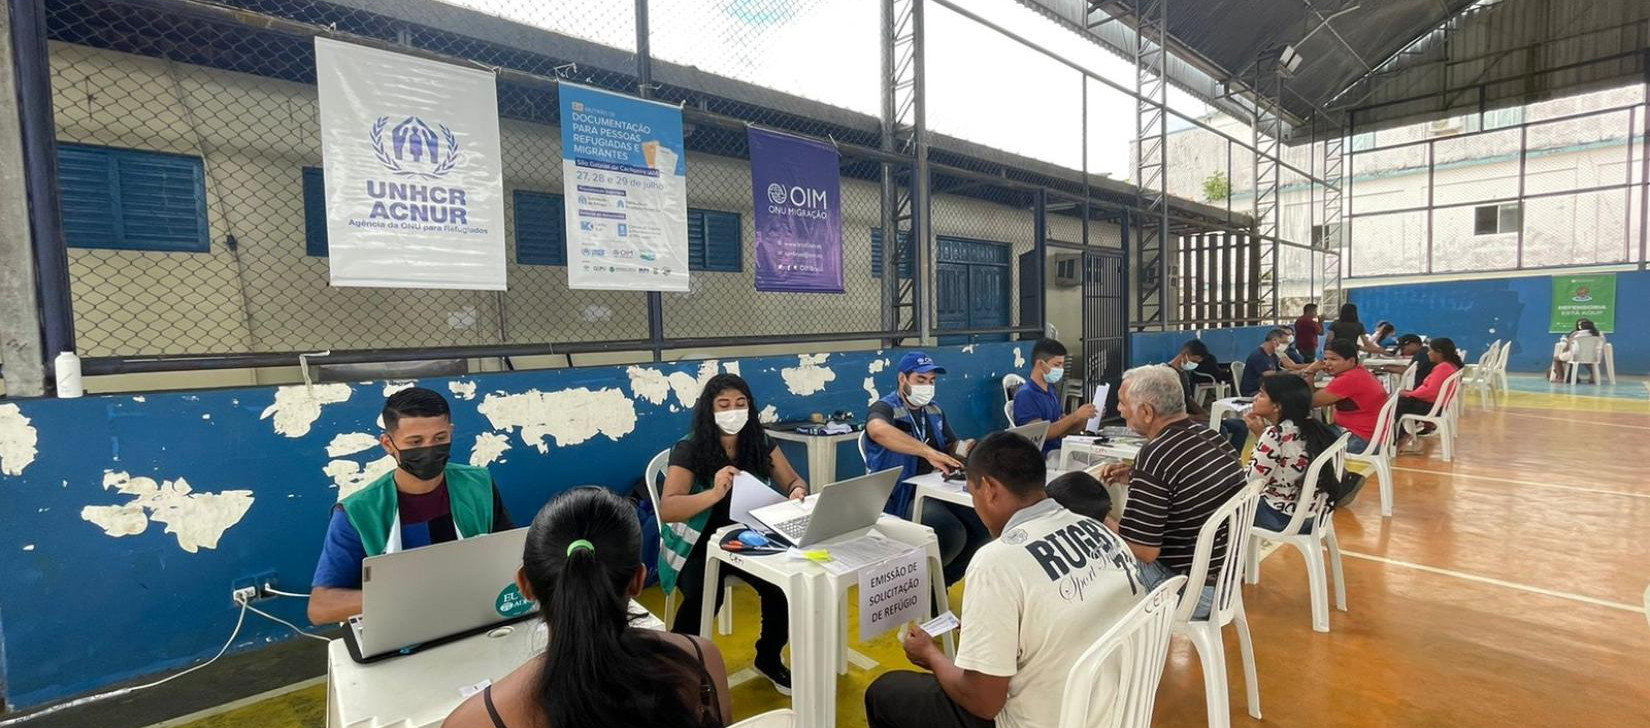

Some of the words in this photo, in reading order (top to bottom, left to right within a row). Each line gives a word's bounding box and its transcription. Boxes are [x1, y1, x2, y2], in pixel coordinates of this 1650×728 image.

[572, 112, 651, 134] DOCUMENTAÇÃO
[572, 123, 598, 135] PARA
[600, 127, 641, 142] PESSOAS
[573, 133, 632, 151] REFUGIADAS
[634, 144, 640, 152] E
[573, 144, 628, 160] MIGRANTES
[366, 180, 467, 206] UNHCR
[592, 173, 604, 183] 28
[616, 175, 628, 186] 29
[630, 179, 641, 187] de
[643, 180, 664, 191] julho
[790, 186, 827, 210] OIM
[369, 201, 468, 225] ACNUR
[768, 205, 787, 215] ONU
[788, 207, 827, 219] MIGRAÇÃO
[348, 219, 386, 230] Agência
[388, 221, 399, 229] da
[400, 222, 421, 230] ONU
[423, 224, 442, 232] para
[443, 224, 489, 234] Refugiados
[870, 566, 907, 588] EMISSÃO
[908, 562, 918, 572] DE
[1059, 566, 1097, 601] Sport
[869, 578, 920, 606] SOLICITAÇÃO
[871, 609, 883, 623] DE
[884, 595, 918, 617] REFÚGIO
